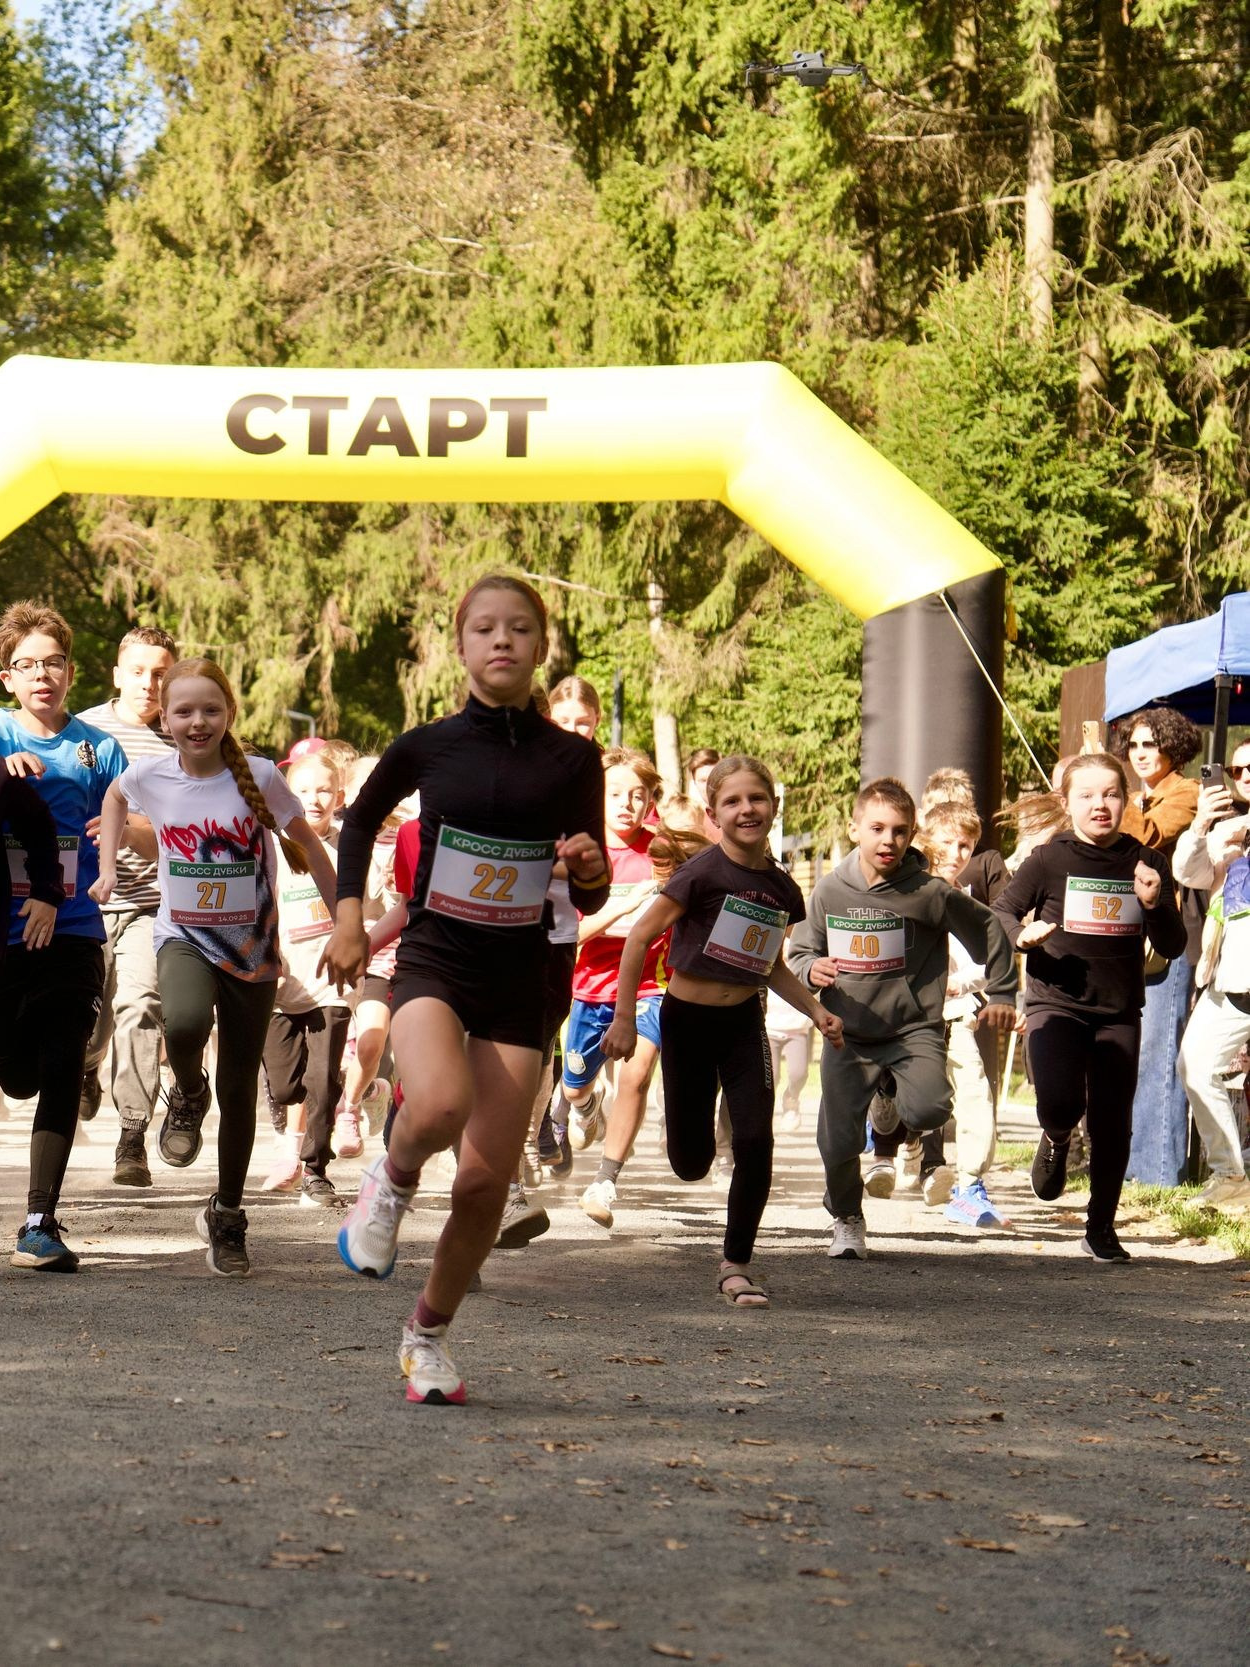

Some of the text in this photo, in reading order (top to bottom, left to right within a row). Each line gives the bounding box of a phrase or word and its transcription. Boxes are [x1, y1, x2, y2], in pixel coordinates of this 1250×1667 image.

[226, 393, 548, 458] СТАРТ
[452, 835, 546, 859] КРОСС ДУБКИ
[177, 865, 247, 877] КРОСС ДУБКИ
[469, 862, 519, 902] 22
[196, 881, 227, 910] 27
[1076, 882, 1135, 893] КРОСС ДУБК
[733, 903, 766, 920] КРОСС
[1091, 896, 1123, 921] 52
[833, 920, 896, 931] КРОСС ДУБКИ
[740, 924, 770, 956] 61
[850, 934, 880, 958] 40
